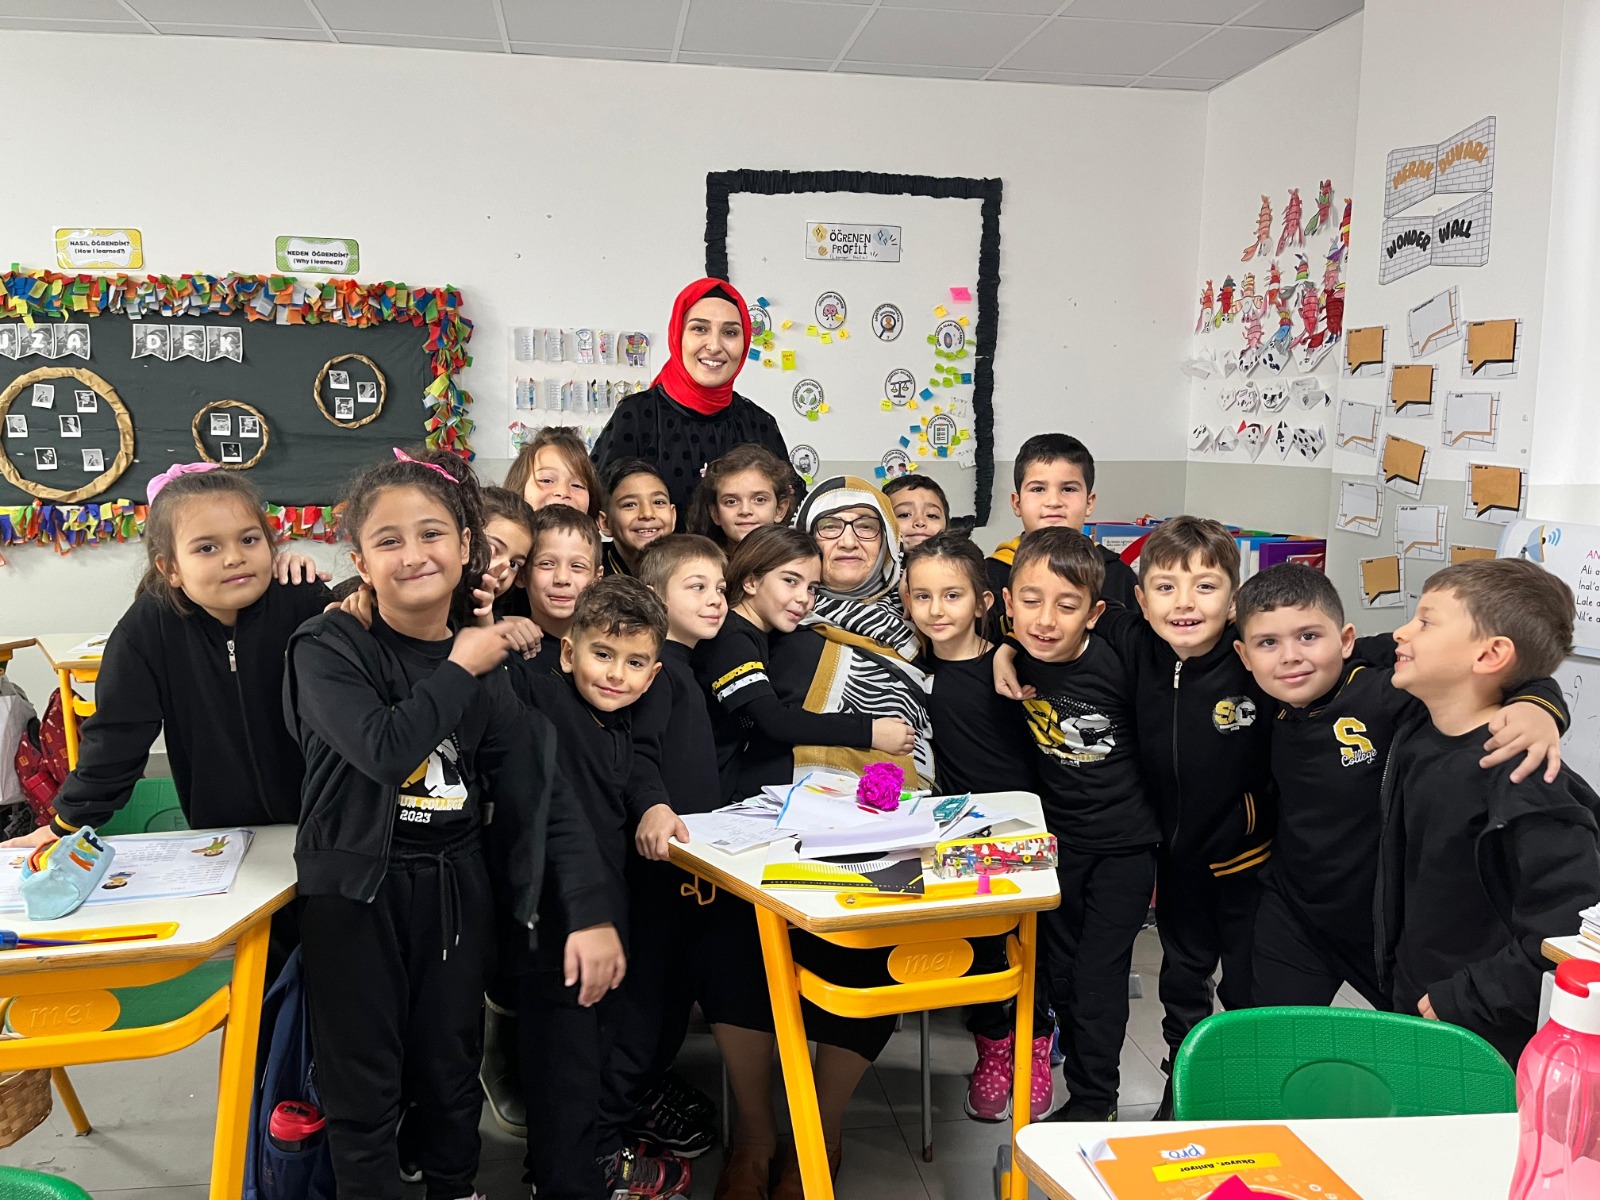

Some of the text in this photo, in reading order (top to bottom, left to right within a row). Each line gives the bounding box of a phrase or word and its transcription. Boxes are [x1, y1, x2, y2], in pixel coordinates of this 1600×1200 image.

[1392, 139, 1488, 190] MERAK DUVARI
[829, 229, 872, 244] ÖĞRENEN
[1386, 218, 1473, 259] WONDER WALL
[832, 242, 868, 255] PROFİLİ
[1580, 564, 1592, 575] Ali
[1576, 595, 1593, 606] Lale
[1332, 716, 1374, 758] S
[1341, 748, 1378, 767] College
[420, 797, 464, 811] COLLEGE
[400, 809, 432, 824] 2023
[904, 950, 954, 975] mei
[30, 1000, 94, 1028] mei
[1168, 1144, 1201, 1159] pro
